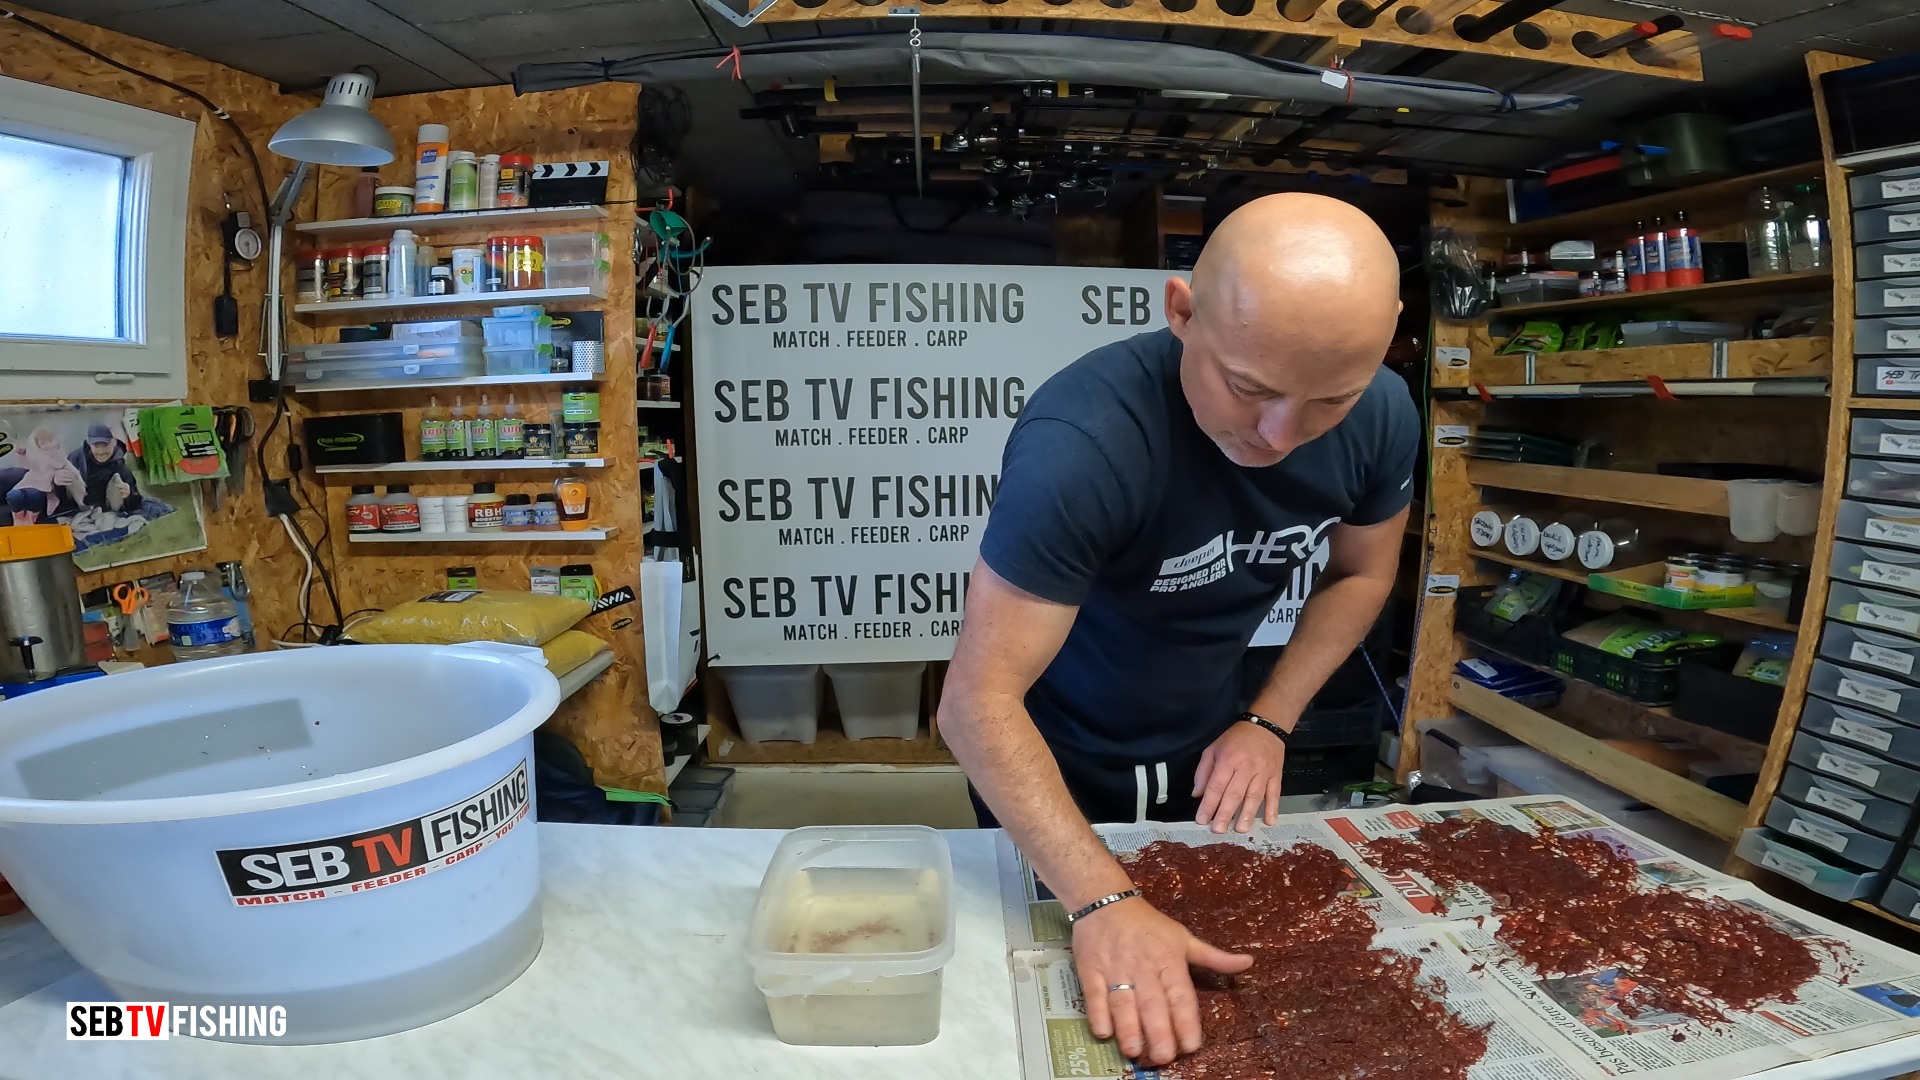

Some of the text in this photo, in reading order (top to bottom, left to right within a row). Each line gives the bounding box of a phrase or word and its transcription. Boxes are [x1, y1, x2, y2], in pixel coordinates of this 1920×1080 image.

[711, 281, 1025, 326] SEB TV FISHING
[1081, 284, 1151, 326] SEB
[772, 330, 830, 349] MATCH
[846, 329, 907, 348] FEEDER
[926, 329, 968, 347] CARP
[714, 376, 1026, 424] SEB TV FISHING
[775, 427, 832, 447] MATCH
[848, 426, 908, 446] FEEDER
[928, 426, 969, 445] CARP
[717, 474, 999, 523] SEB TV FISHIN
[778, 527, 834, 546] MATCH
[851, 525, 910, 544] FEEDER
[929, 524, 970, 543] CARP
[1149, 567, 1227, 593] PRO ANGLERS
[1152, 558, 1227, 587] DESIGNED FOR
[723, 571, 970, 619] SEB TV FISHI
[783, 623, 838, 641] MATCH
[854, 621, 912, 640] FEEDER
[930, 619, 963, 637] CAR
[240, 768, 527, 890] SEB TV FISHING
[236, 890, 325, 906] MATCH
[352, 866, 427, 893] FEEDER
[445, 842, 483, 866] CARP
[495, 821, 514, 839] YOU
[1542, 1005, 1576, 1029] d'être
[1572, 1028, 1614, 1059] besoin
[1068, 1047, 1091, 1076] 25%
[1609, 1054, 1637, 1075] Pas
